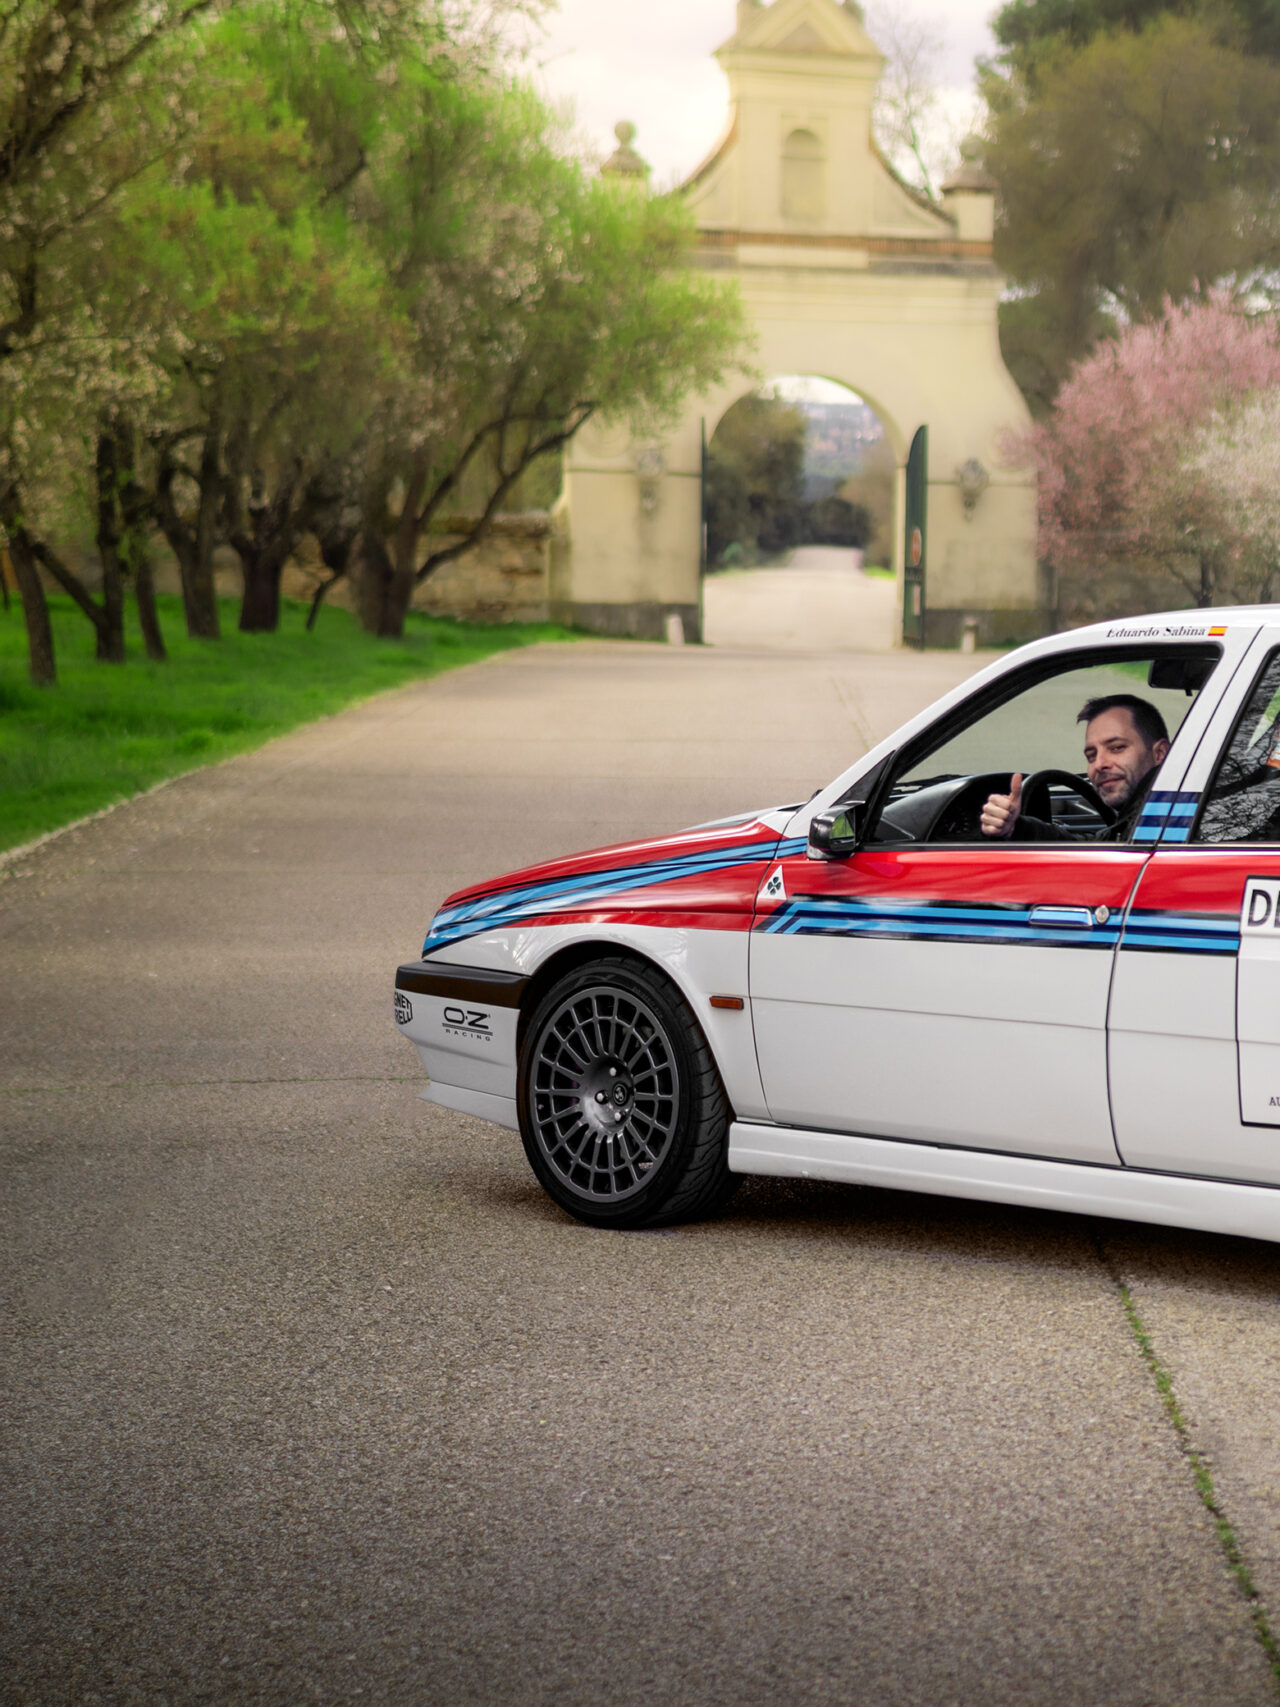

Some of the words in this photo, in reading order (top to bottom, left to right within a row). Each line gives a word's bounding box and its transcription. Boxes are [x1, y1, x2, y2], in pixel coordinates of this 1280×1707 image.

[1106, 627, 1160, 638] Eduardo
[1163, 626, 1206, 637] Sabina
[445, 1028, 491, 1041] RACING
